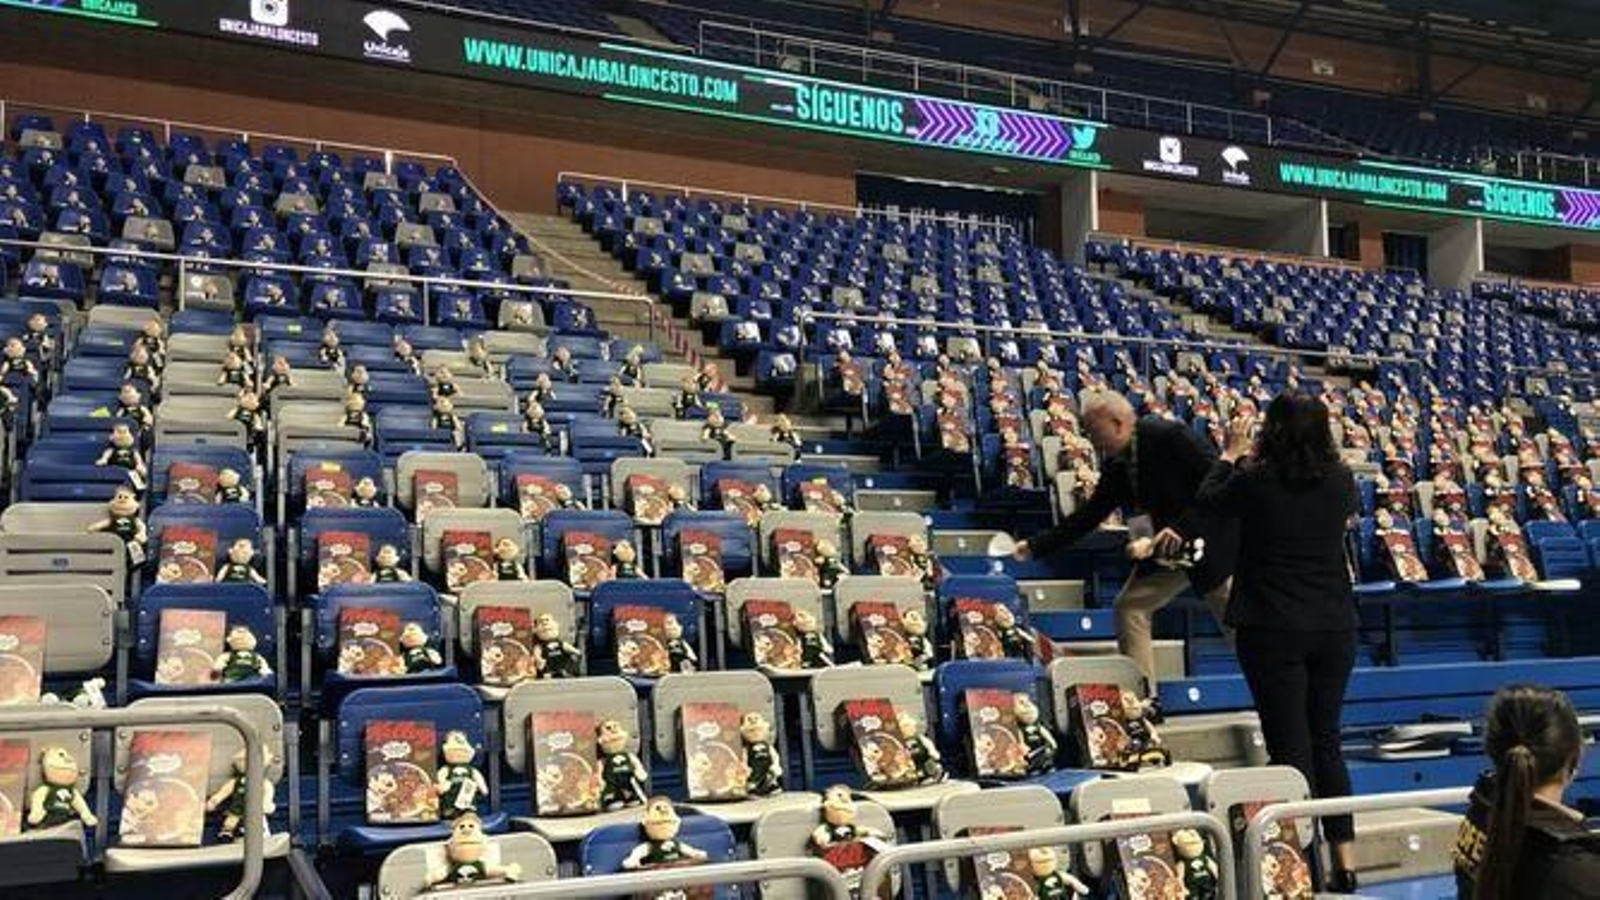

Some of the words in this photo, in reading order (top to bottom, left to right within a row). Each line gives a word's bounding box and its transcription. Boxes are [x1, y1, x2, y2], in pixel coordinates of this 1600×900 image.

[464, 37, 738, 104] WWW.UNICAJABALONCESTO.COM
[795, 83, 905, 134] SÍGUENOS
[1483, 179, 1556, 218] SÍGUENOS
